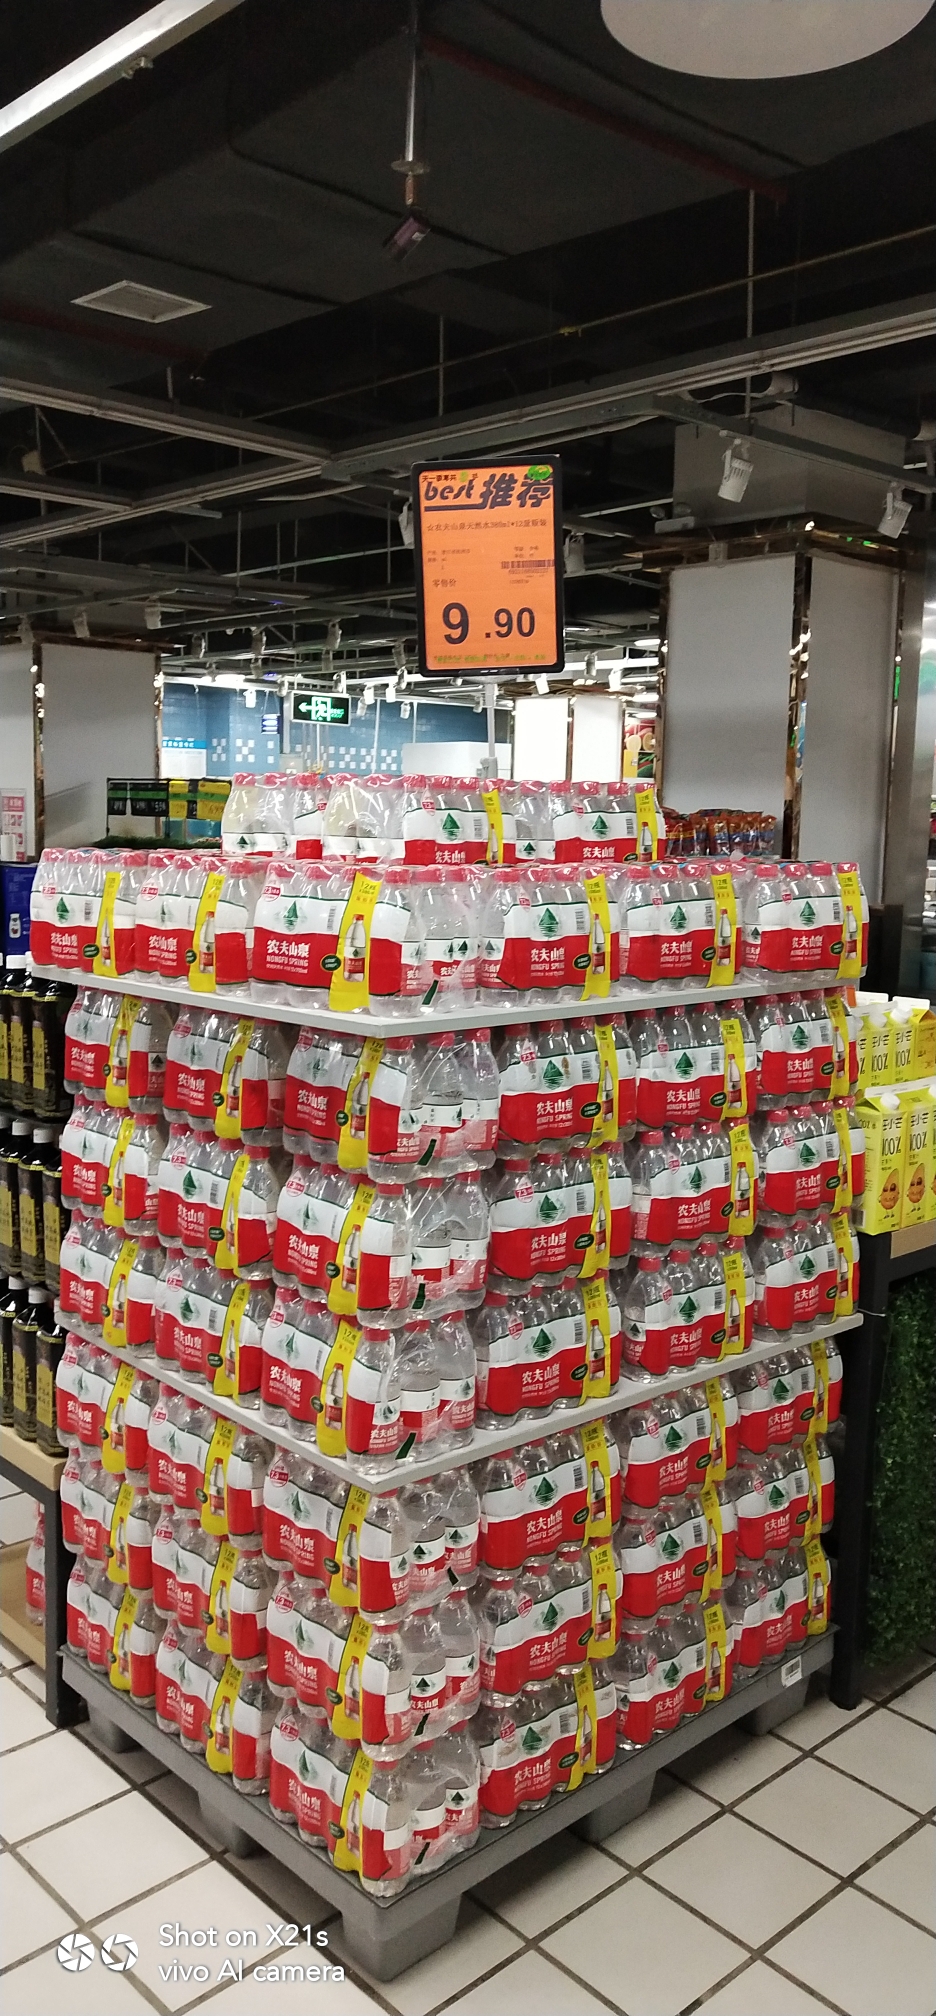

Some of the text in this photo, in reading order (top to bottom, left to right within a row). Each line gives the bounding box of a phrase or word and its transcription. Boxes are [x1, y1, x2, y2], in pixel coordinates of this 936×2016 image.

[425, 473, 553, 509] best 推荐
[442, 602, 469, 644] 9
[266, 939, 311, 958] 农夫山泉
[660, 940, 693, 955] 农夫山泉
[792, 935, 823, 949] 农夫山泉
[531, 946, 565, 962] 农夫山泉
[667, 1088, 701, 1103] 农夫山泉
[537, 1098, 573, 1116] 农夫山泉
[678, 1198, 711, 1217] 农夫山泉
[531, 1232, 567, 1249] 农夫山泉
[670, 1328, 703, 1346] 农夫山泉
[522, 1363, 560, 1385] 农夫山泉
[659, 1456, 689, 1478] 农夫山泉
[527, 1509, 563, 1535] 农夫山泉
[656, 1564, 686, 1585] 农夫山泉
[529, 1632, 567, 1658] 农夫山泉
[514, 1758, 551, 1786] 农夫山泉
